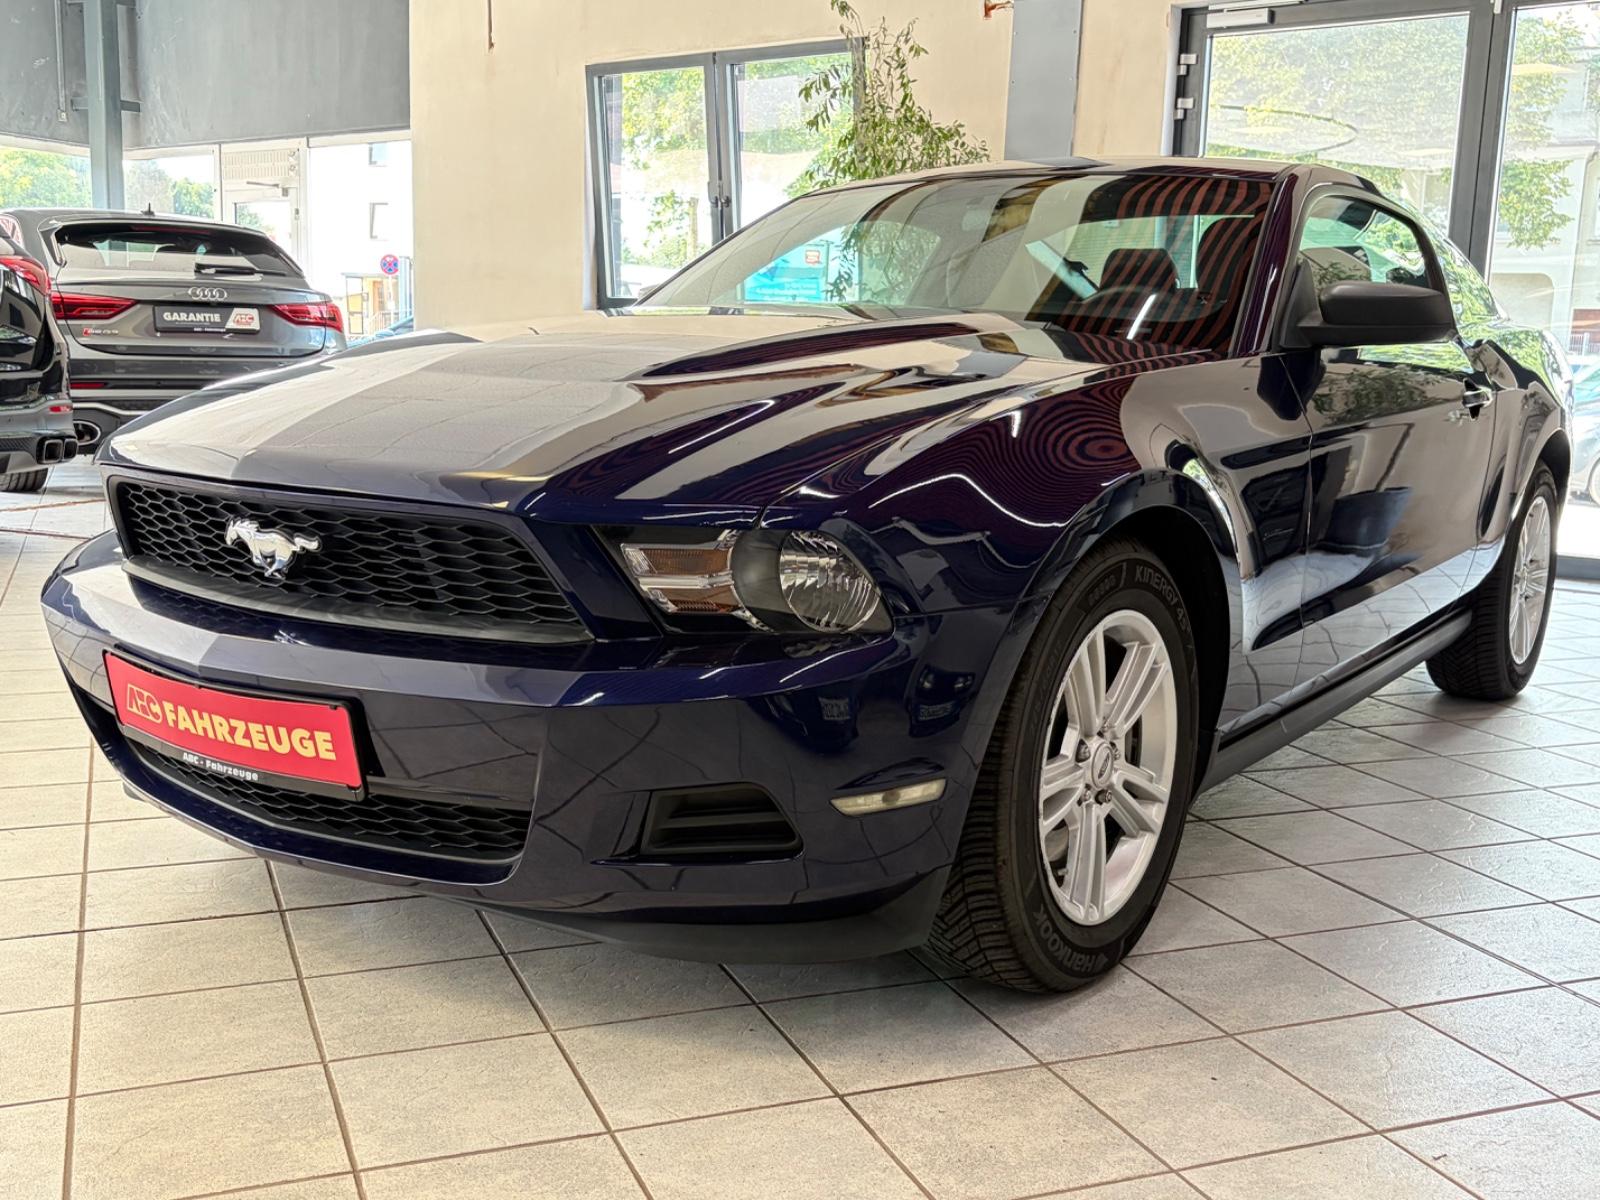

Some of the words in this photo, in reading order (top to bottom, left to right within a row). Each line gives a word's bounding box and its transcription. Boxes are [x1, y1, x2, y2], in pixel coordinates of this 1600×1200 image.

[163, 312, 221, 322] GARANTIE
[1135, 564, 1178, 606] KINERGY
[162, 701, 336, 760] FAHRZEUGE
[183, 752, 199, 764] ABC
[205, 759, 259, 780] Fahrzeuge
